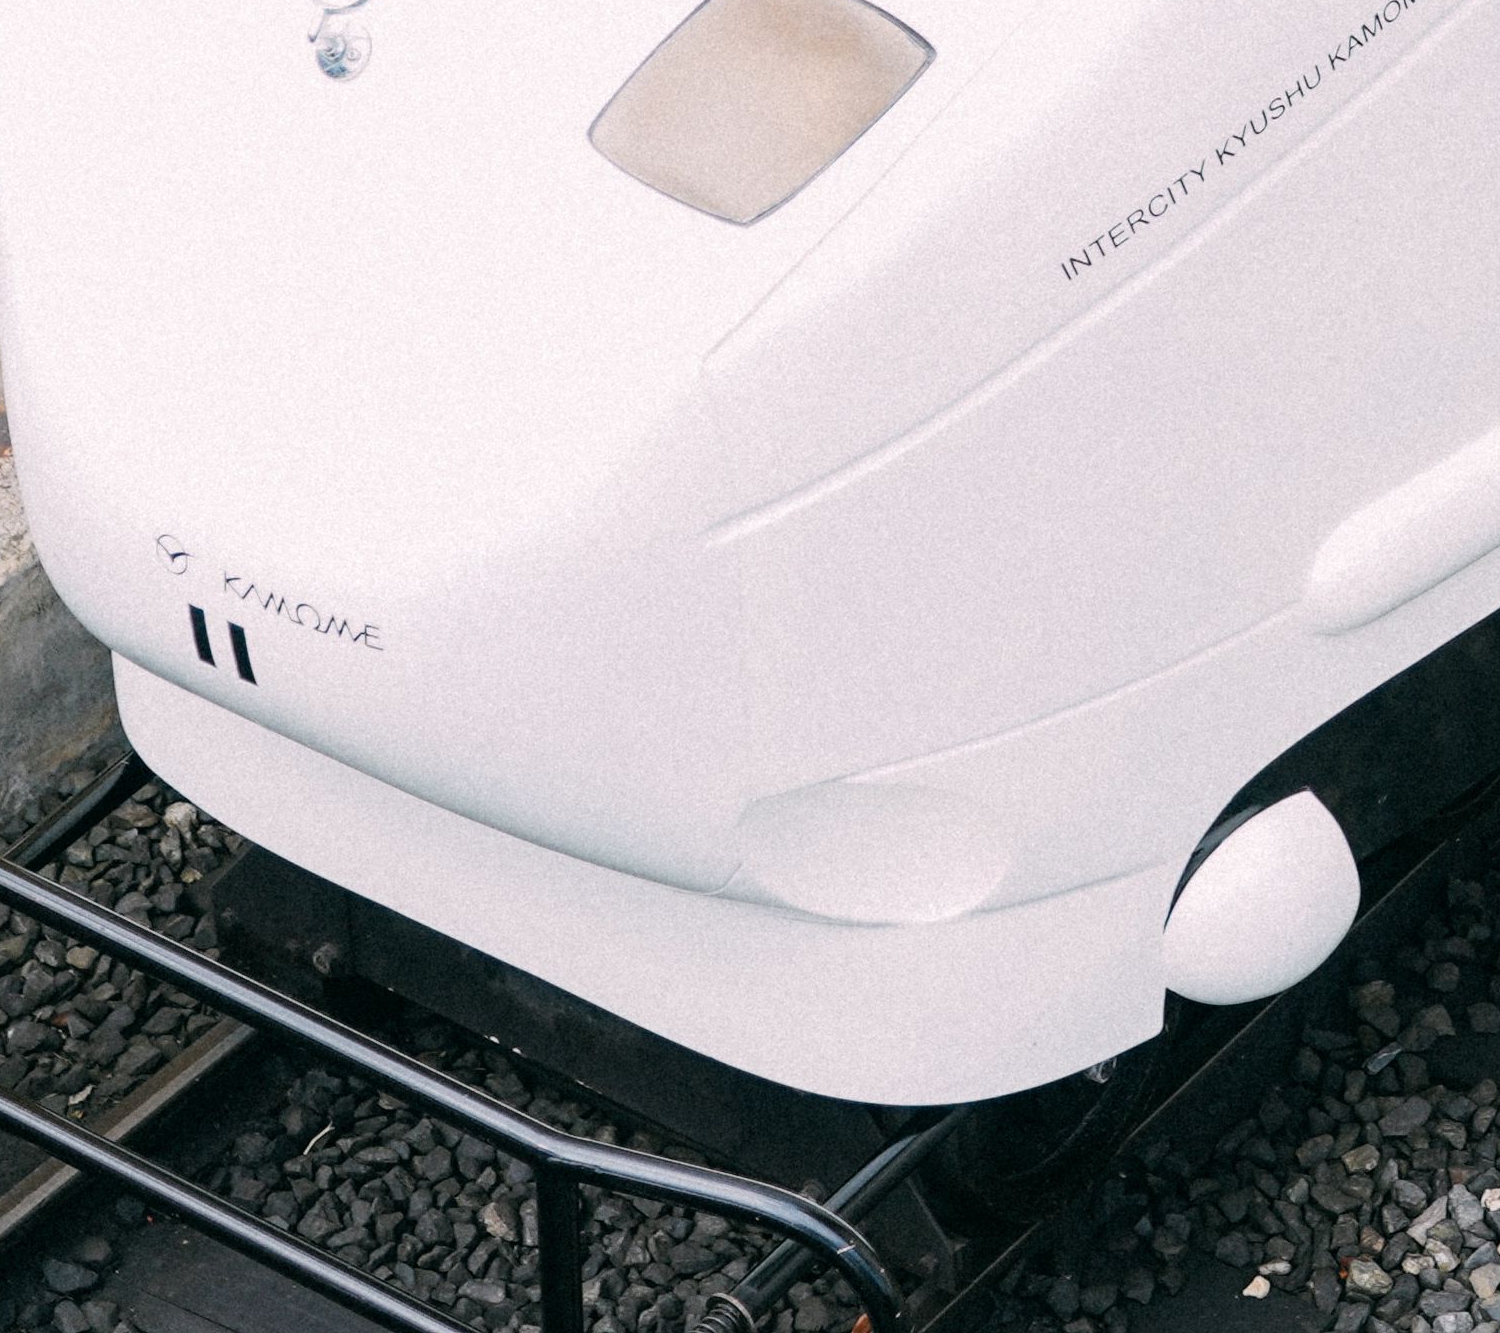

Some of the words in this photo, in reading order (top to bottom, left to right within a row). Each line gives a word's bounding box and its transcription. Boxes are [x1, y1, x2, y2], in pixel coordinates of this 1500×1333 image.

[1060, 159, 1207, 281] INTERCITY
[1214, 64, 1323, 166] KYUSHU
[223, 570, 385, 651] KAMOME
